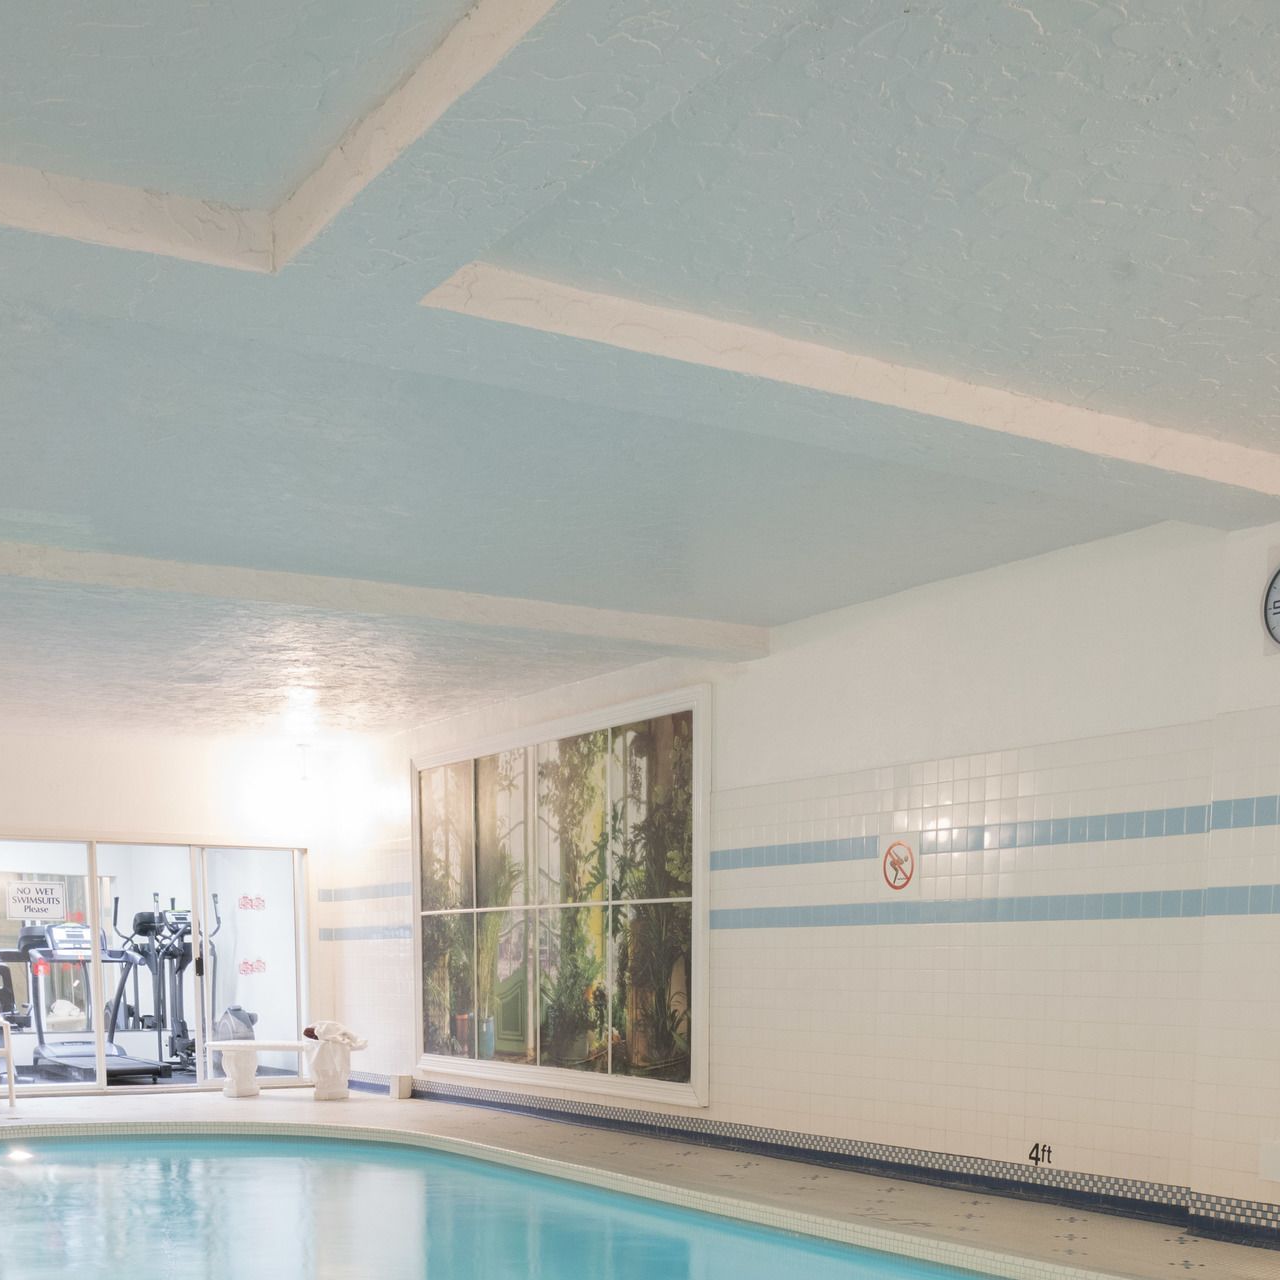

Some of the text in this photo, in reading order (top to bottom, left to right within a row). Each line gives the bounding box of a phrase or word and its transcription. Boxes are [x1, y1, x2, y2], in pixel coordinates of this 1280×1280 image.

[16, 887, 54, 896] NO WET
[12, 896, 60, 905] SWIMSUITS
[24, 905, 48, 913] Please
[1028, 1142, 1053, 1166] 4ft
